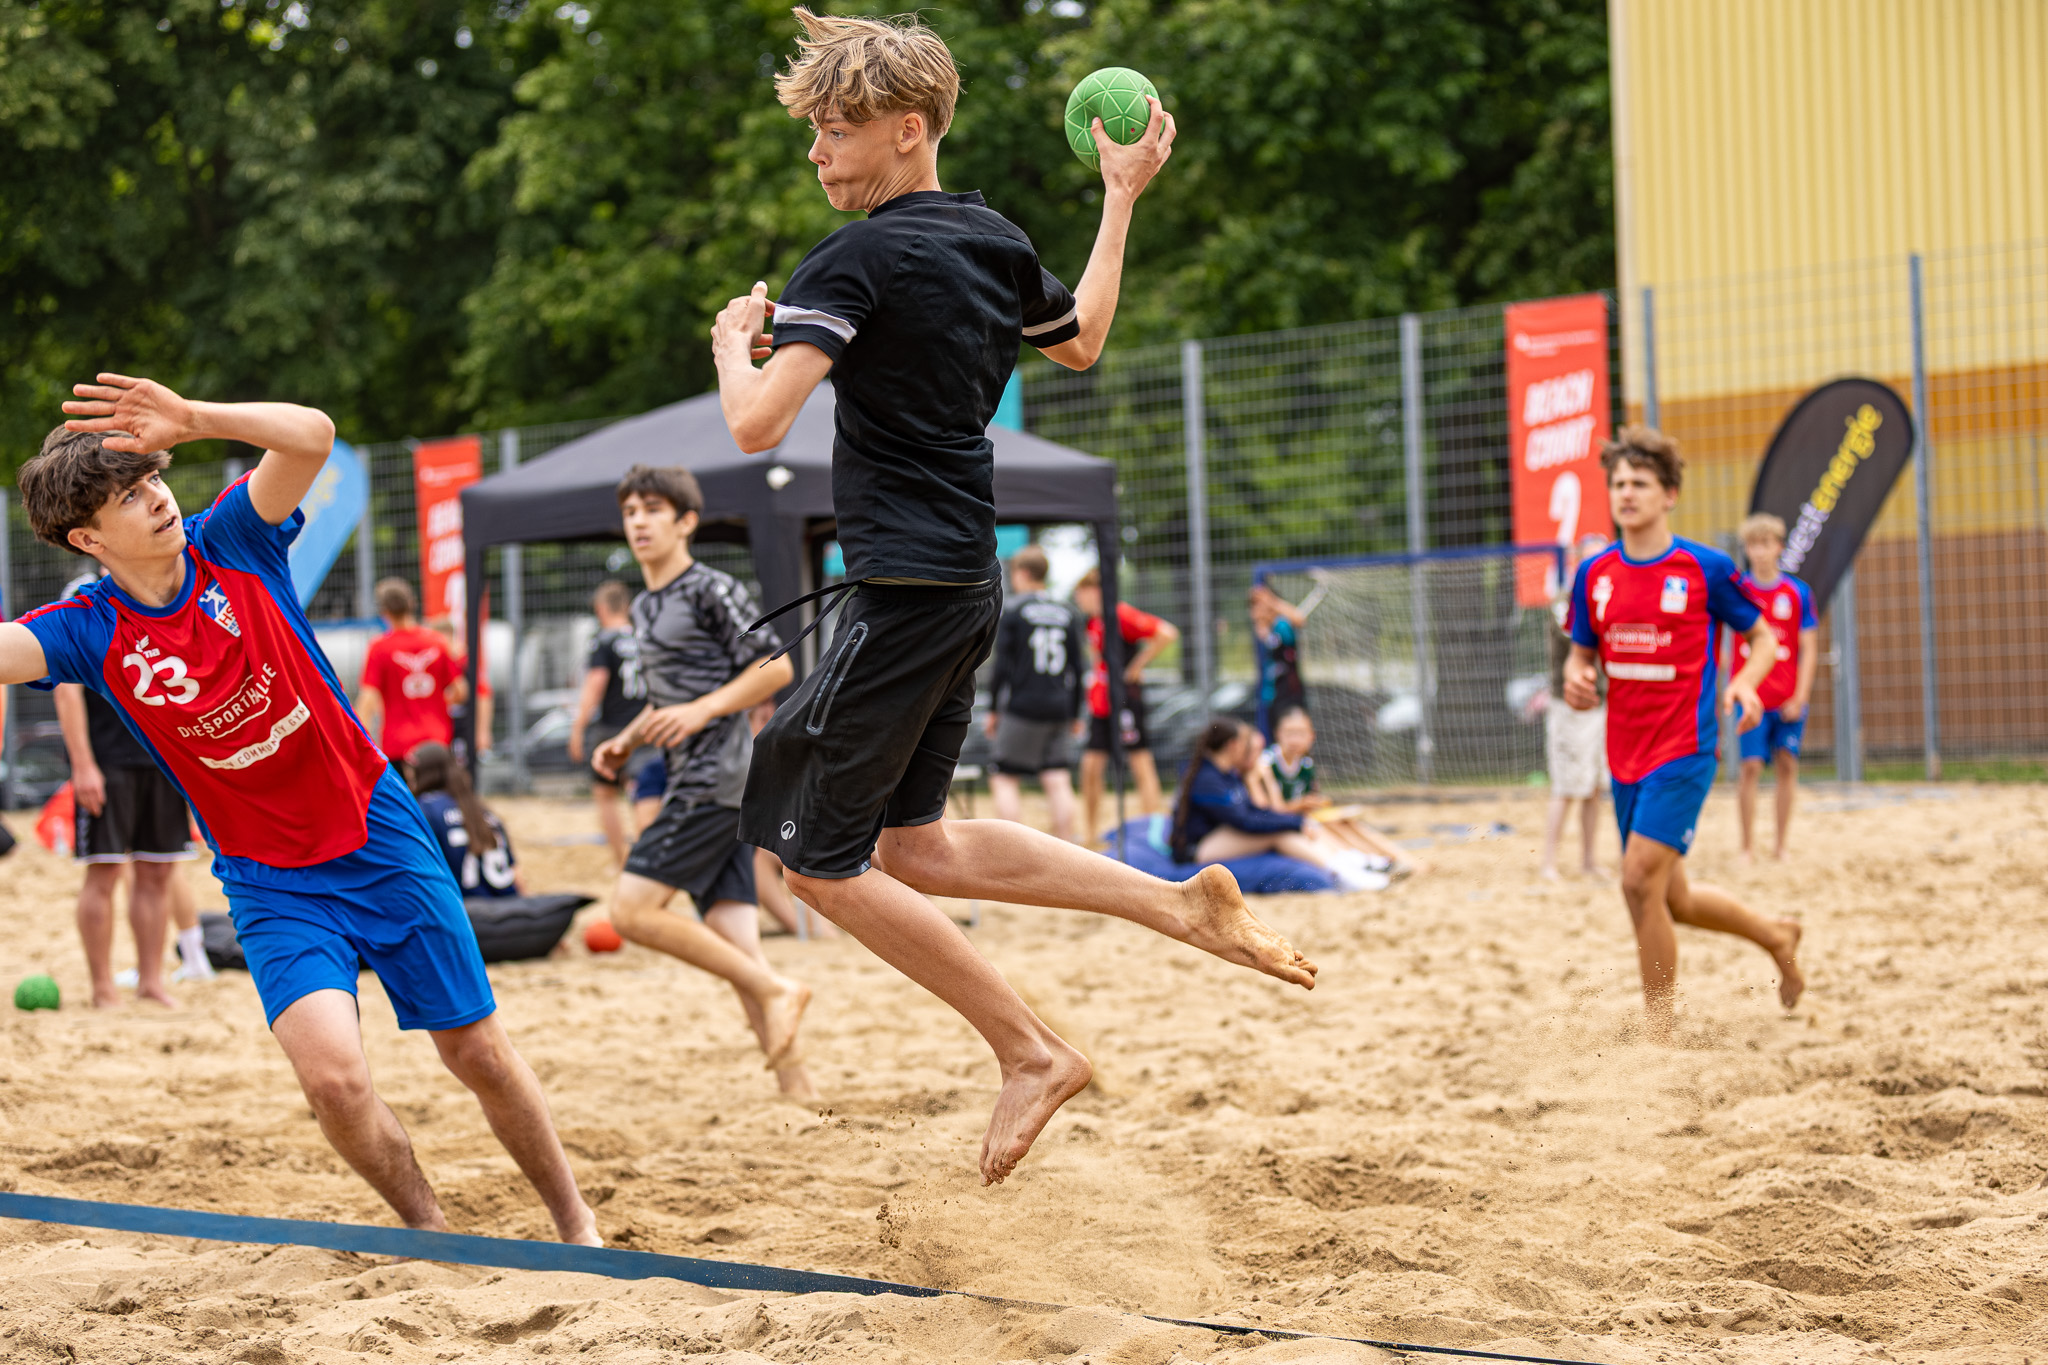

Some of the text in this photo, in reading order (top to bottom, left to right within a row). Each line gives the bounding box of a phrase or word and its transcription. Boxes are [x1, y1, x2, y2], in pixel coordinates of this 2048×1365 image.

[1523, 369, 1594, 427] BEACH
[1525, 414, 1596, 472] COURT
[1028, 627, 1067, 676] 15
[123, 653, 200, 706] 23
[237, 725, 287, 765] COMMUNITY
